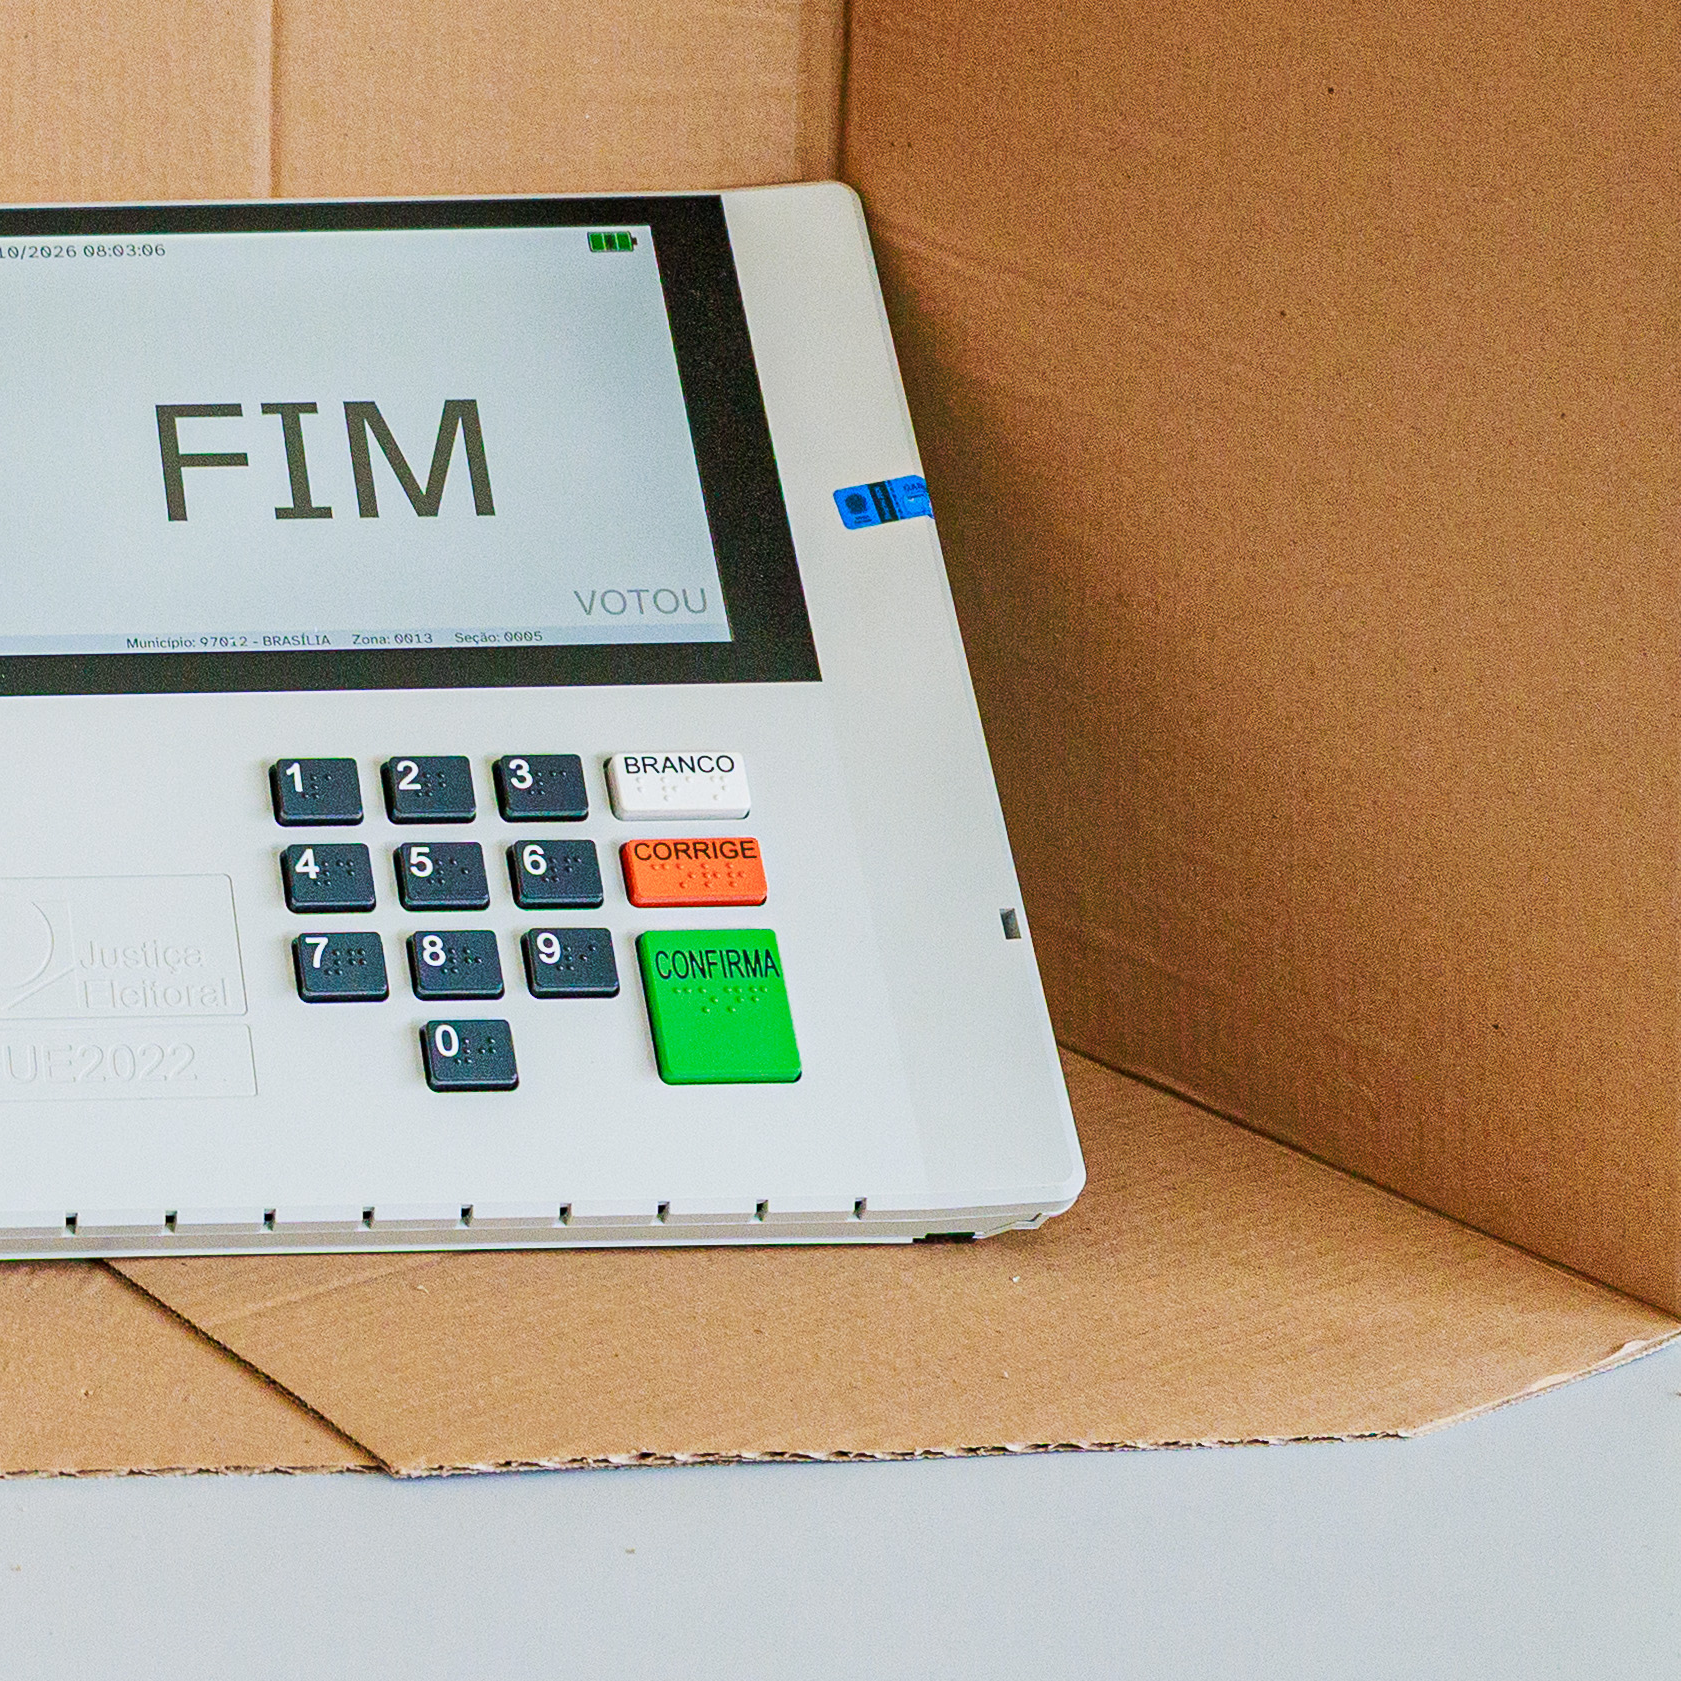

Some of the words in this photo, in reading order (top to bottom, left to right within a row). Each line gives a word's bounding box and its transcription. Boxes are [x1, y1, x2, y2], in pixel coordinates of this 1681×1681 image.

[83, 243, 166, 258] 08:03:06
[155, 398, 496, 522] FIM
[573, 587, 708, 617] VOTOU
[126, 637, 196, 650] Município:
[262, 633, 331, 647] BRASÍLIA
[352, 633, 391, 645] Zona:
[394, 632, 433, 644] 0013
[454, 631, 500, 645] Seção:
[504, 630, 543, 642] 0005
[285, 765, 305, 793] 1
[396, 761, 421, 791] 2
[510, 759, 533, 789] 3
[623, 755, 735, 775] BRANCO
[295, 848, 320, 879] 4
[409, 846, 434, 878] 5
[523, 844, 547, 876] 6
[634, 840, 758, 861] CORRIGE
[79, 940, 204, 975] Justiça
[305, 937, 329, 969] 7
[422, 936, 446, 967] 8
[537, 932, 562, 964] 9
[654, 948, 781, 980] CONFIRMA
[78, 978, 231, 1009] Eleitoral
[435, 1025, 459, 1058] 0
[3, 1041, 198, 1084] UE2022
